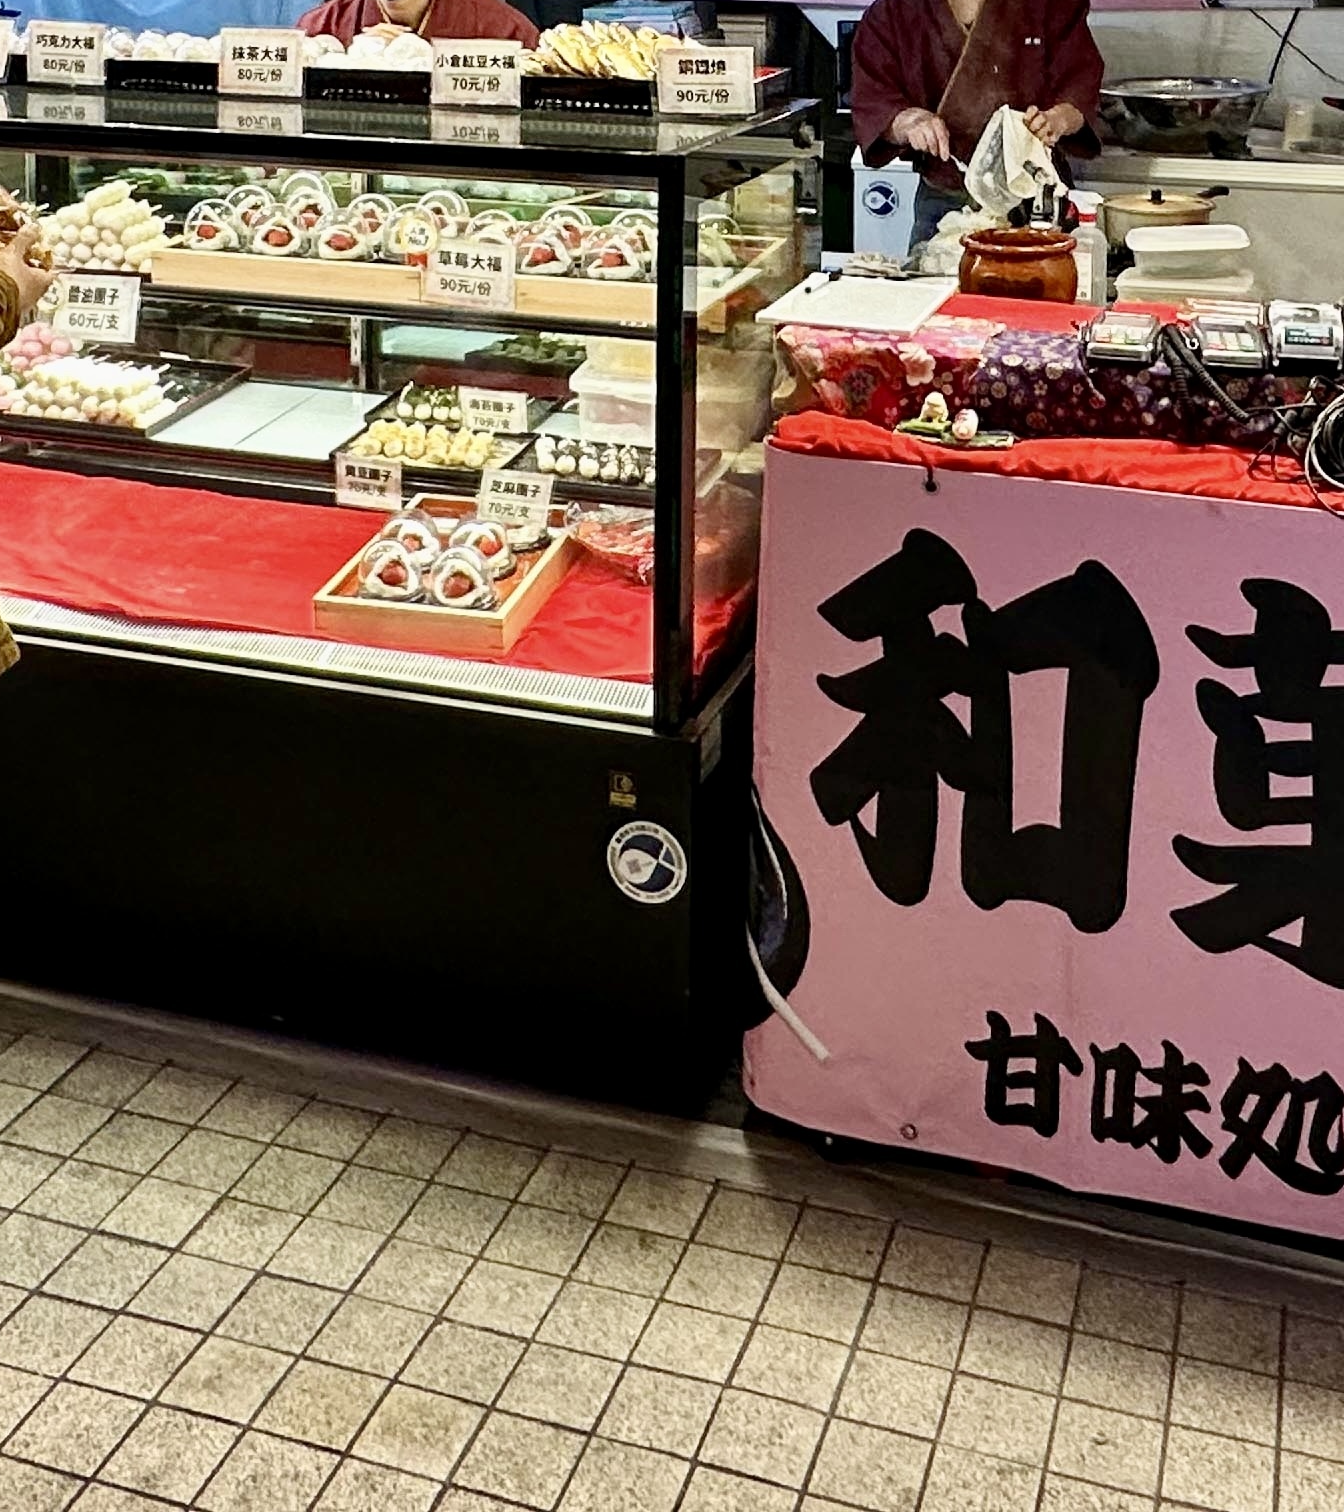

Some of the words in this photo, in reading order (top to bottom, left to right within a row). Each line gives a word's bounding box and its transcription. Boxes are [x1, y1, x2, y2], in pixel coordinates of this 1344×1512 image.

[35, 34, 95, 51] 巧克力大福
[43, 58, 86, 74] 80元/份
[435, 53, 516, 71] 小倉紅豆大福
[237, 68, 283, 83] 80元/份
[452, 76, 501, 93] 70元/份
[676, 87, 731, 105] 90元/份
[440, 277, 492, 297] 90元/份
[68, 312, 120, 330] 60元/支
[488, 501, 531, 519] 70元/支
